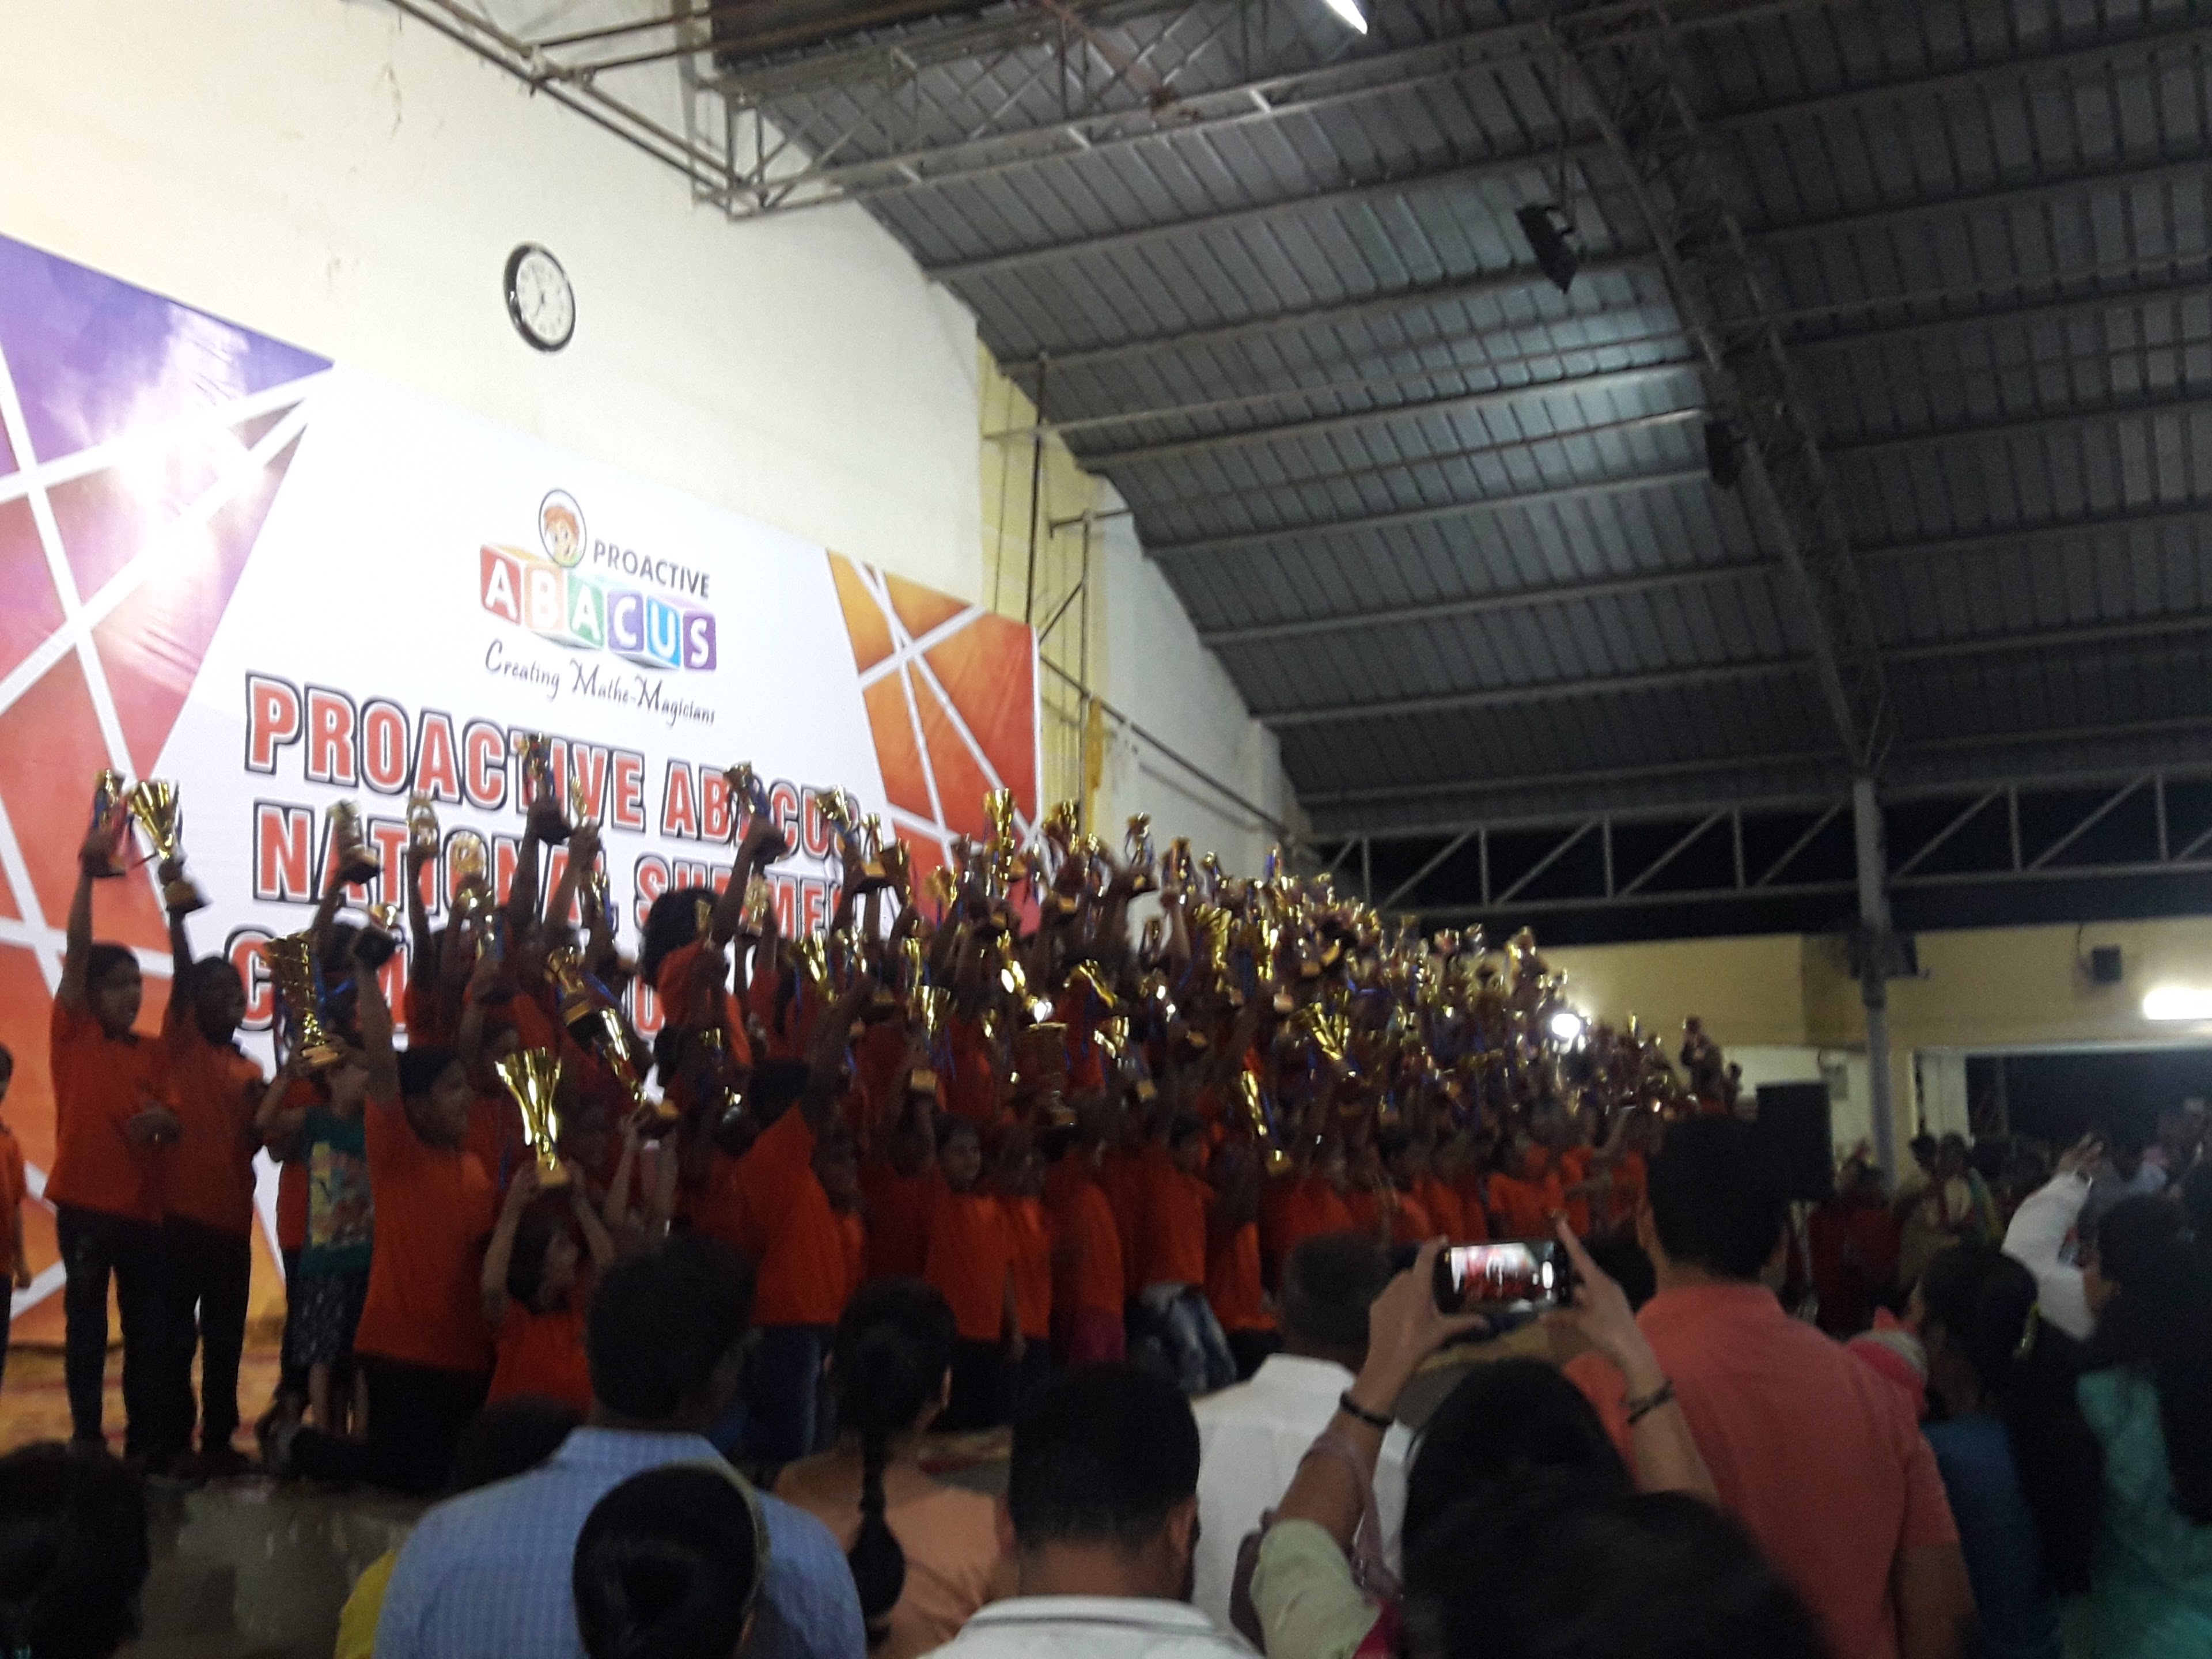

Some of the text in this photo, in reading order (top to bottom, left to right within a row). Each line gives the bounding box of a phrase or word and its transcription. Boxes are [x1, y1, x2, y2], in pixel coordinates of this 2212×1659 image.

[593, 538, 710, 600] PROACTIVE
[484, 555, 710, 668] ABACUS
[484, 637, 560, 701] Creating
[660, 756, 861, 861] ABCU
